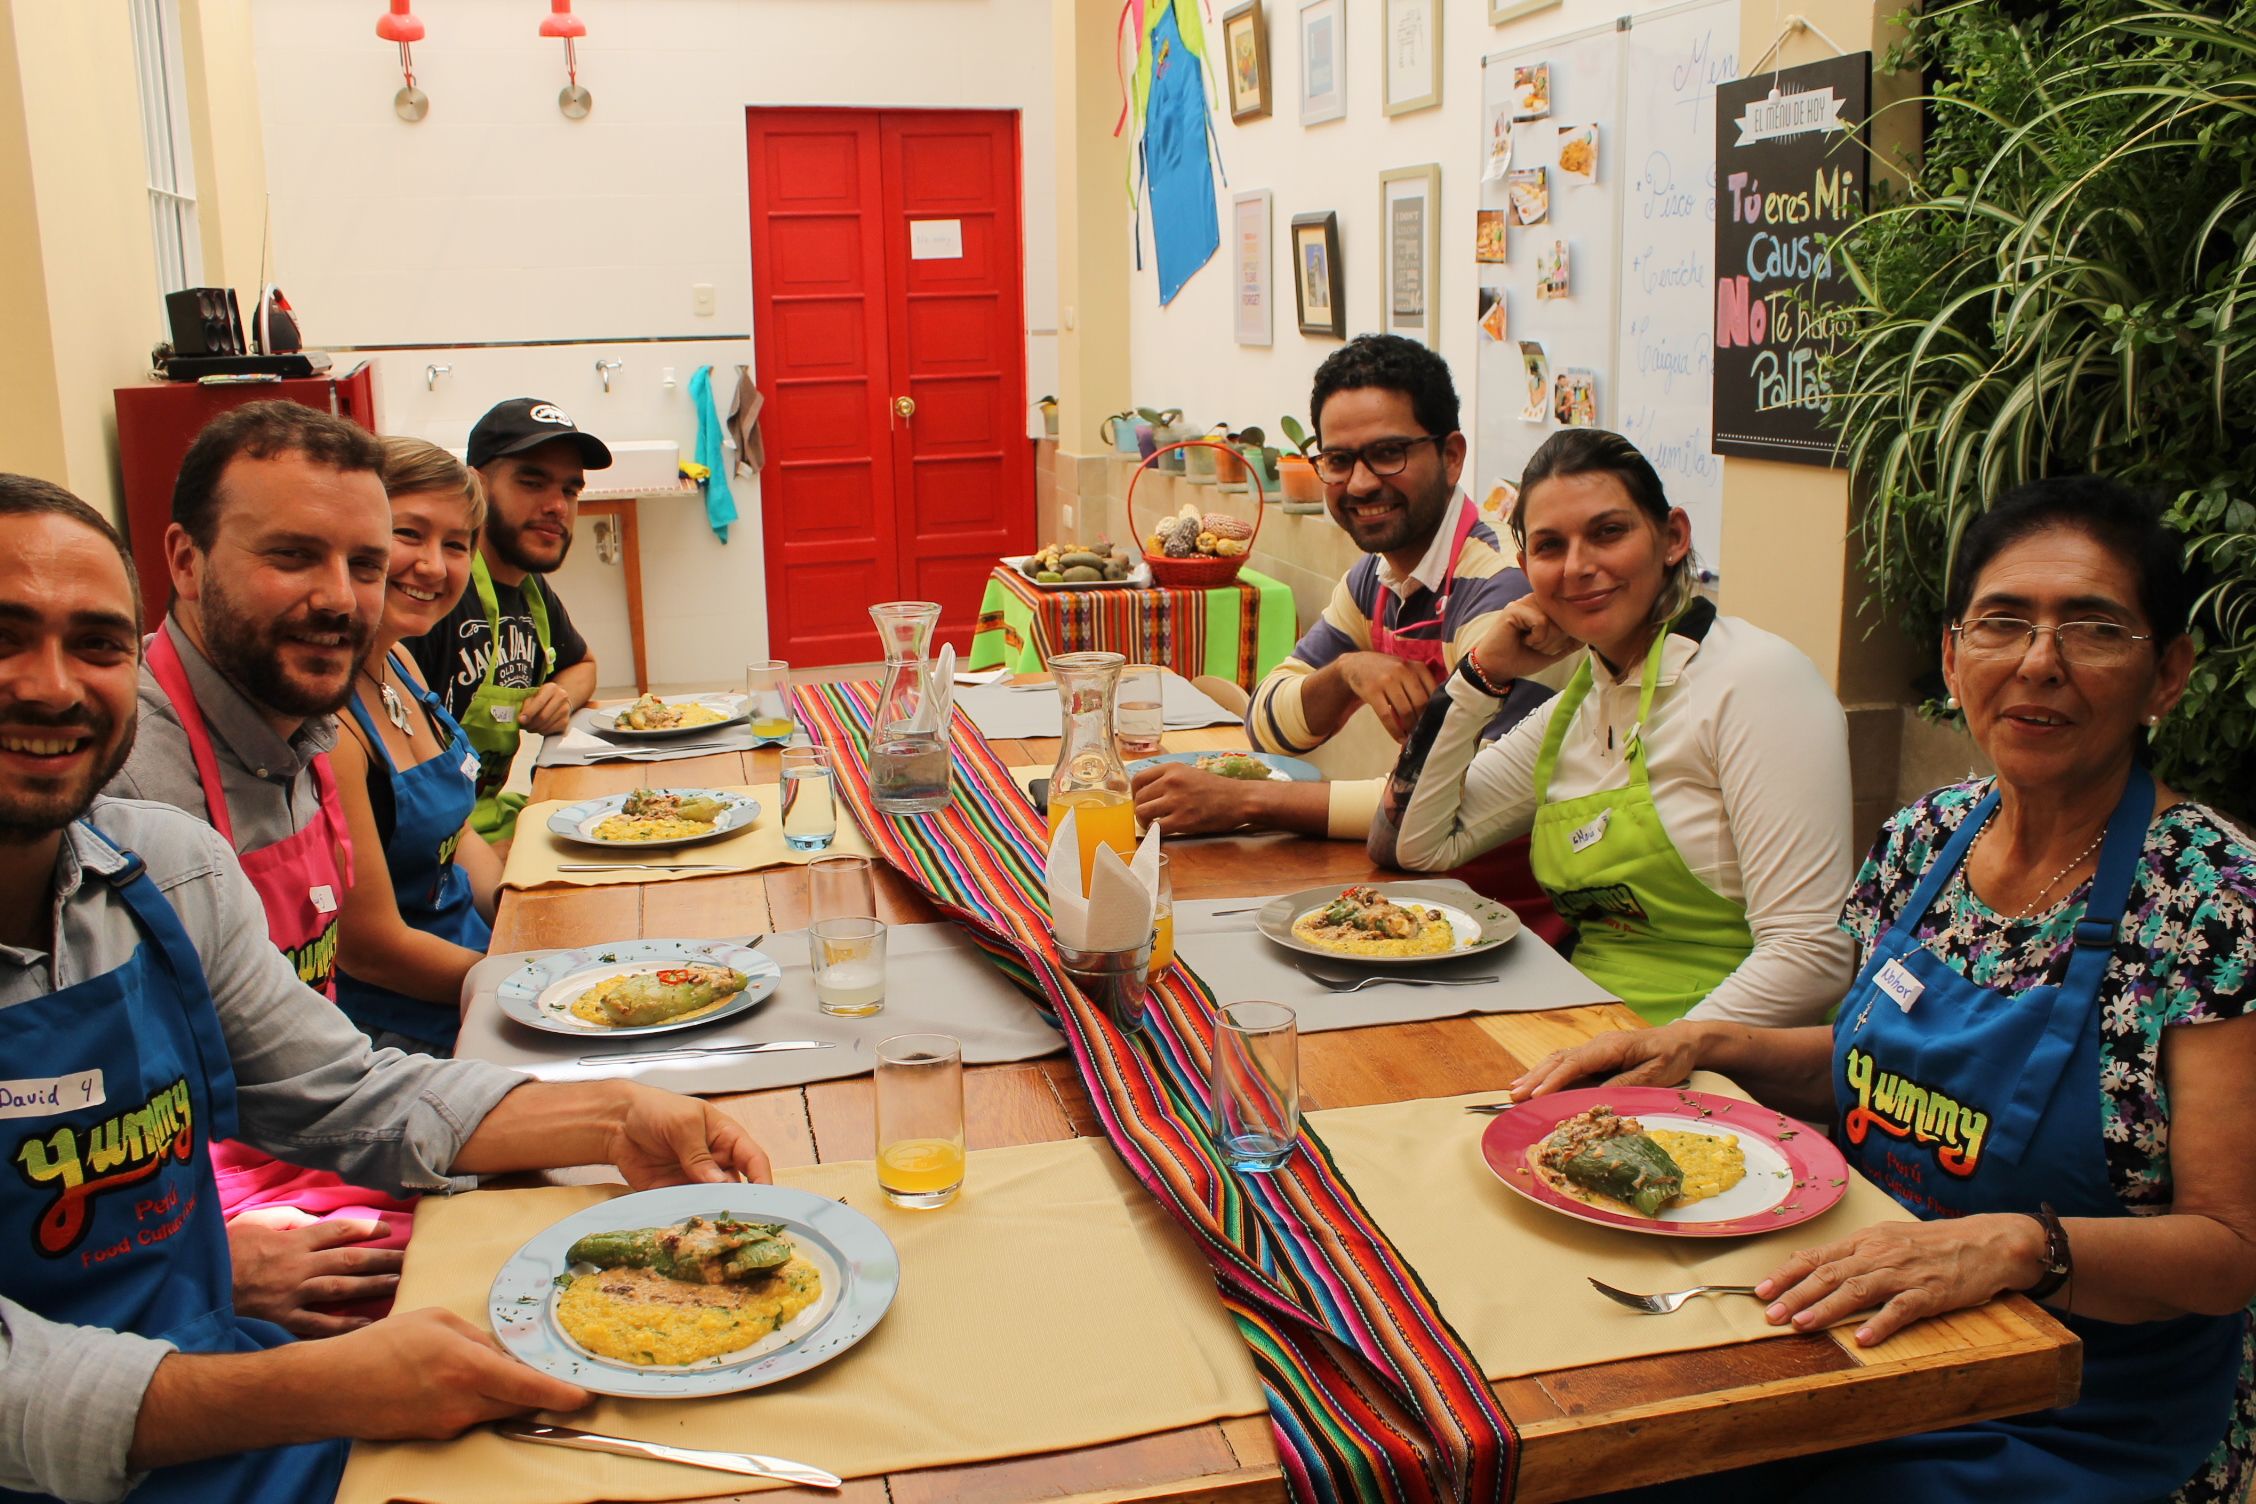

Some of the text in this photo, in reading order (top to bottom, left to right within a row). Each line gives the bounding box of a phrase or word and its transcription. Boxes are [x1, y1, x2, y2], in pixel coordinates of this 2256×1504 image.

[1754, 95, 1826, 133] EL MENU DE HOY
[1764, 191, 1811, 225] eres
[1814, 163, 1854, 221] Mi
[1746, 231, 1832, 283] Causa
[1716, 275, 1767, 349] No
[499, 664, 515, 679] OLD
[0, 1084, 60, 1108] David
[1846, 1048, 1988, 1177] Yummy
[17, 1078, 193, 1252] Yummy
